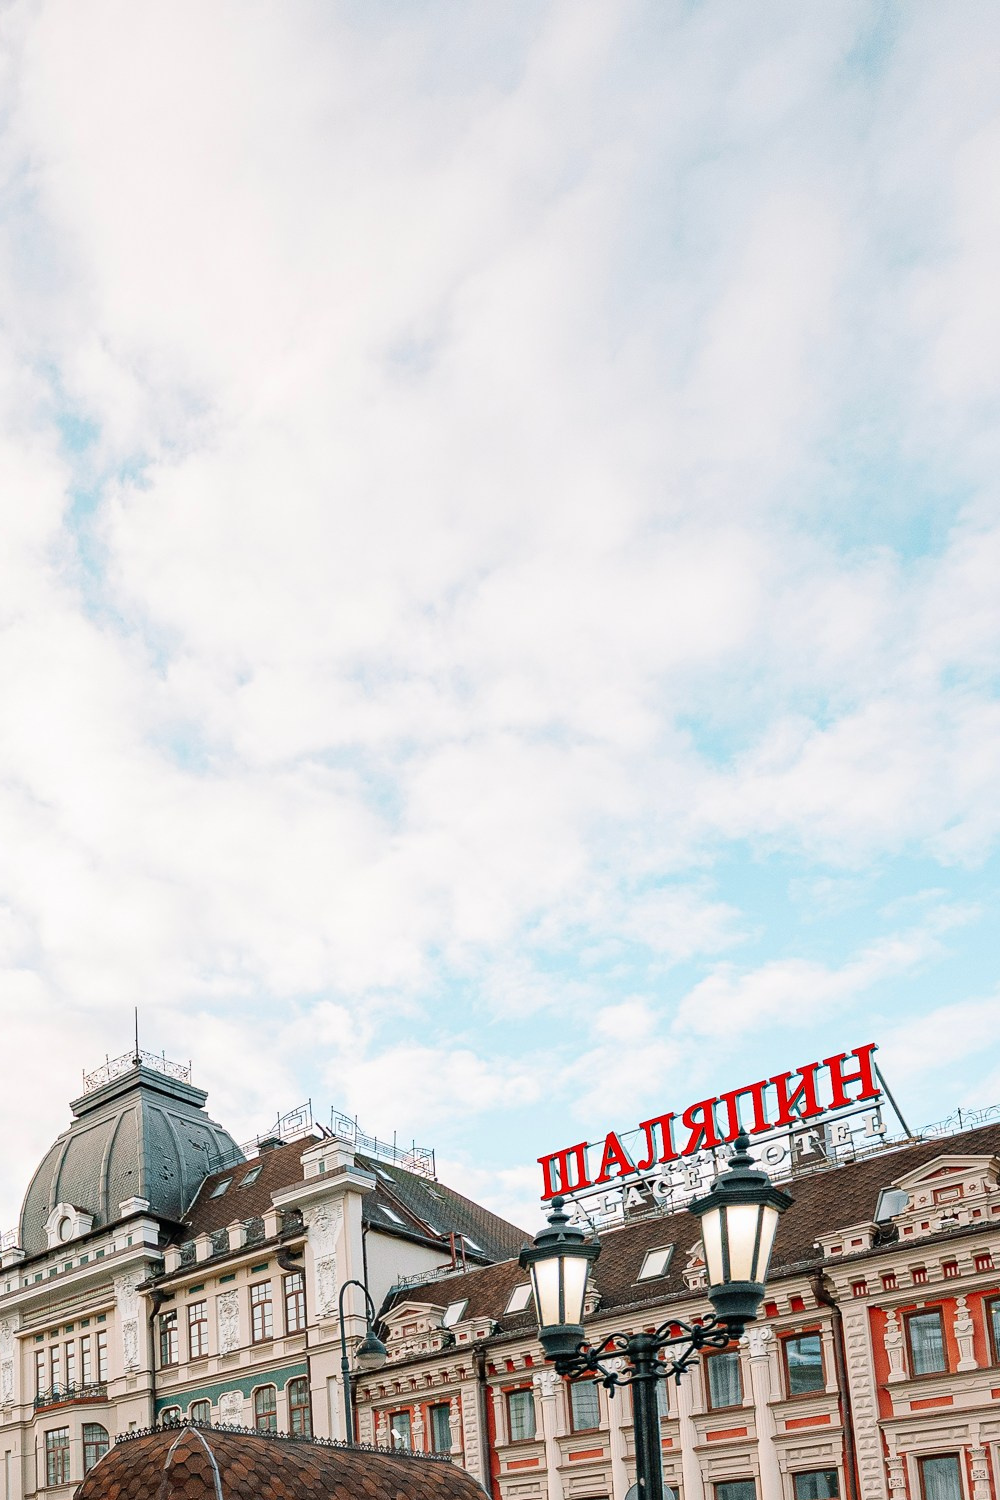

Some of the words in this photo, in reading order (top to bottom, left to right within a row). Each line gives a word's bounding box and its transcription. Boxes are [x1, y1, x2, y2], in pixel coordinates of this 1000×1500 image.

[537, 1043, 881, 1200] ШАЛЯПИН
[570, 1168, 702, 1225] ALACE
[760, 1114, 887, 1165] OTEL
[661, 1145, 735, 1176] KAZAN
